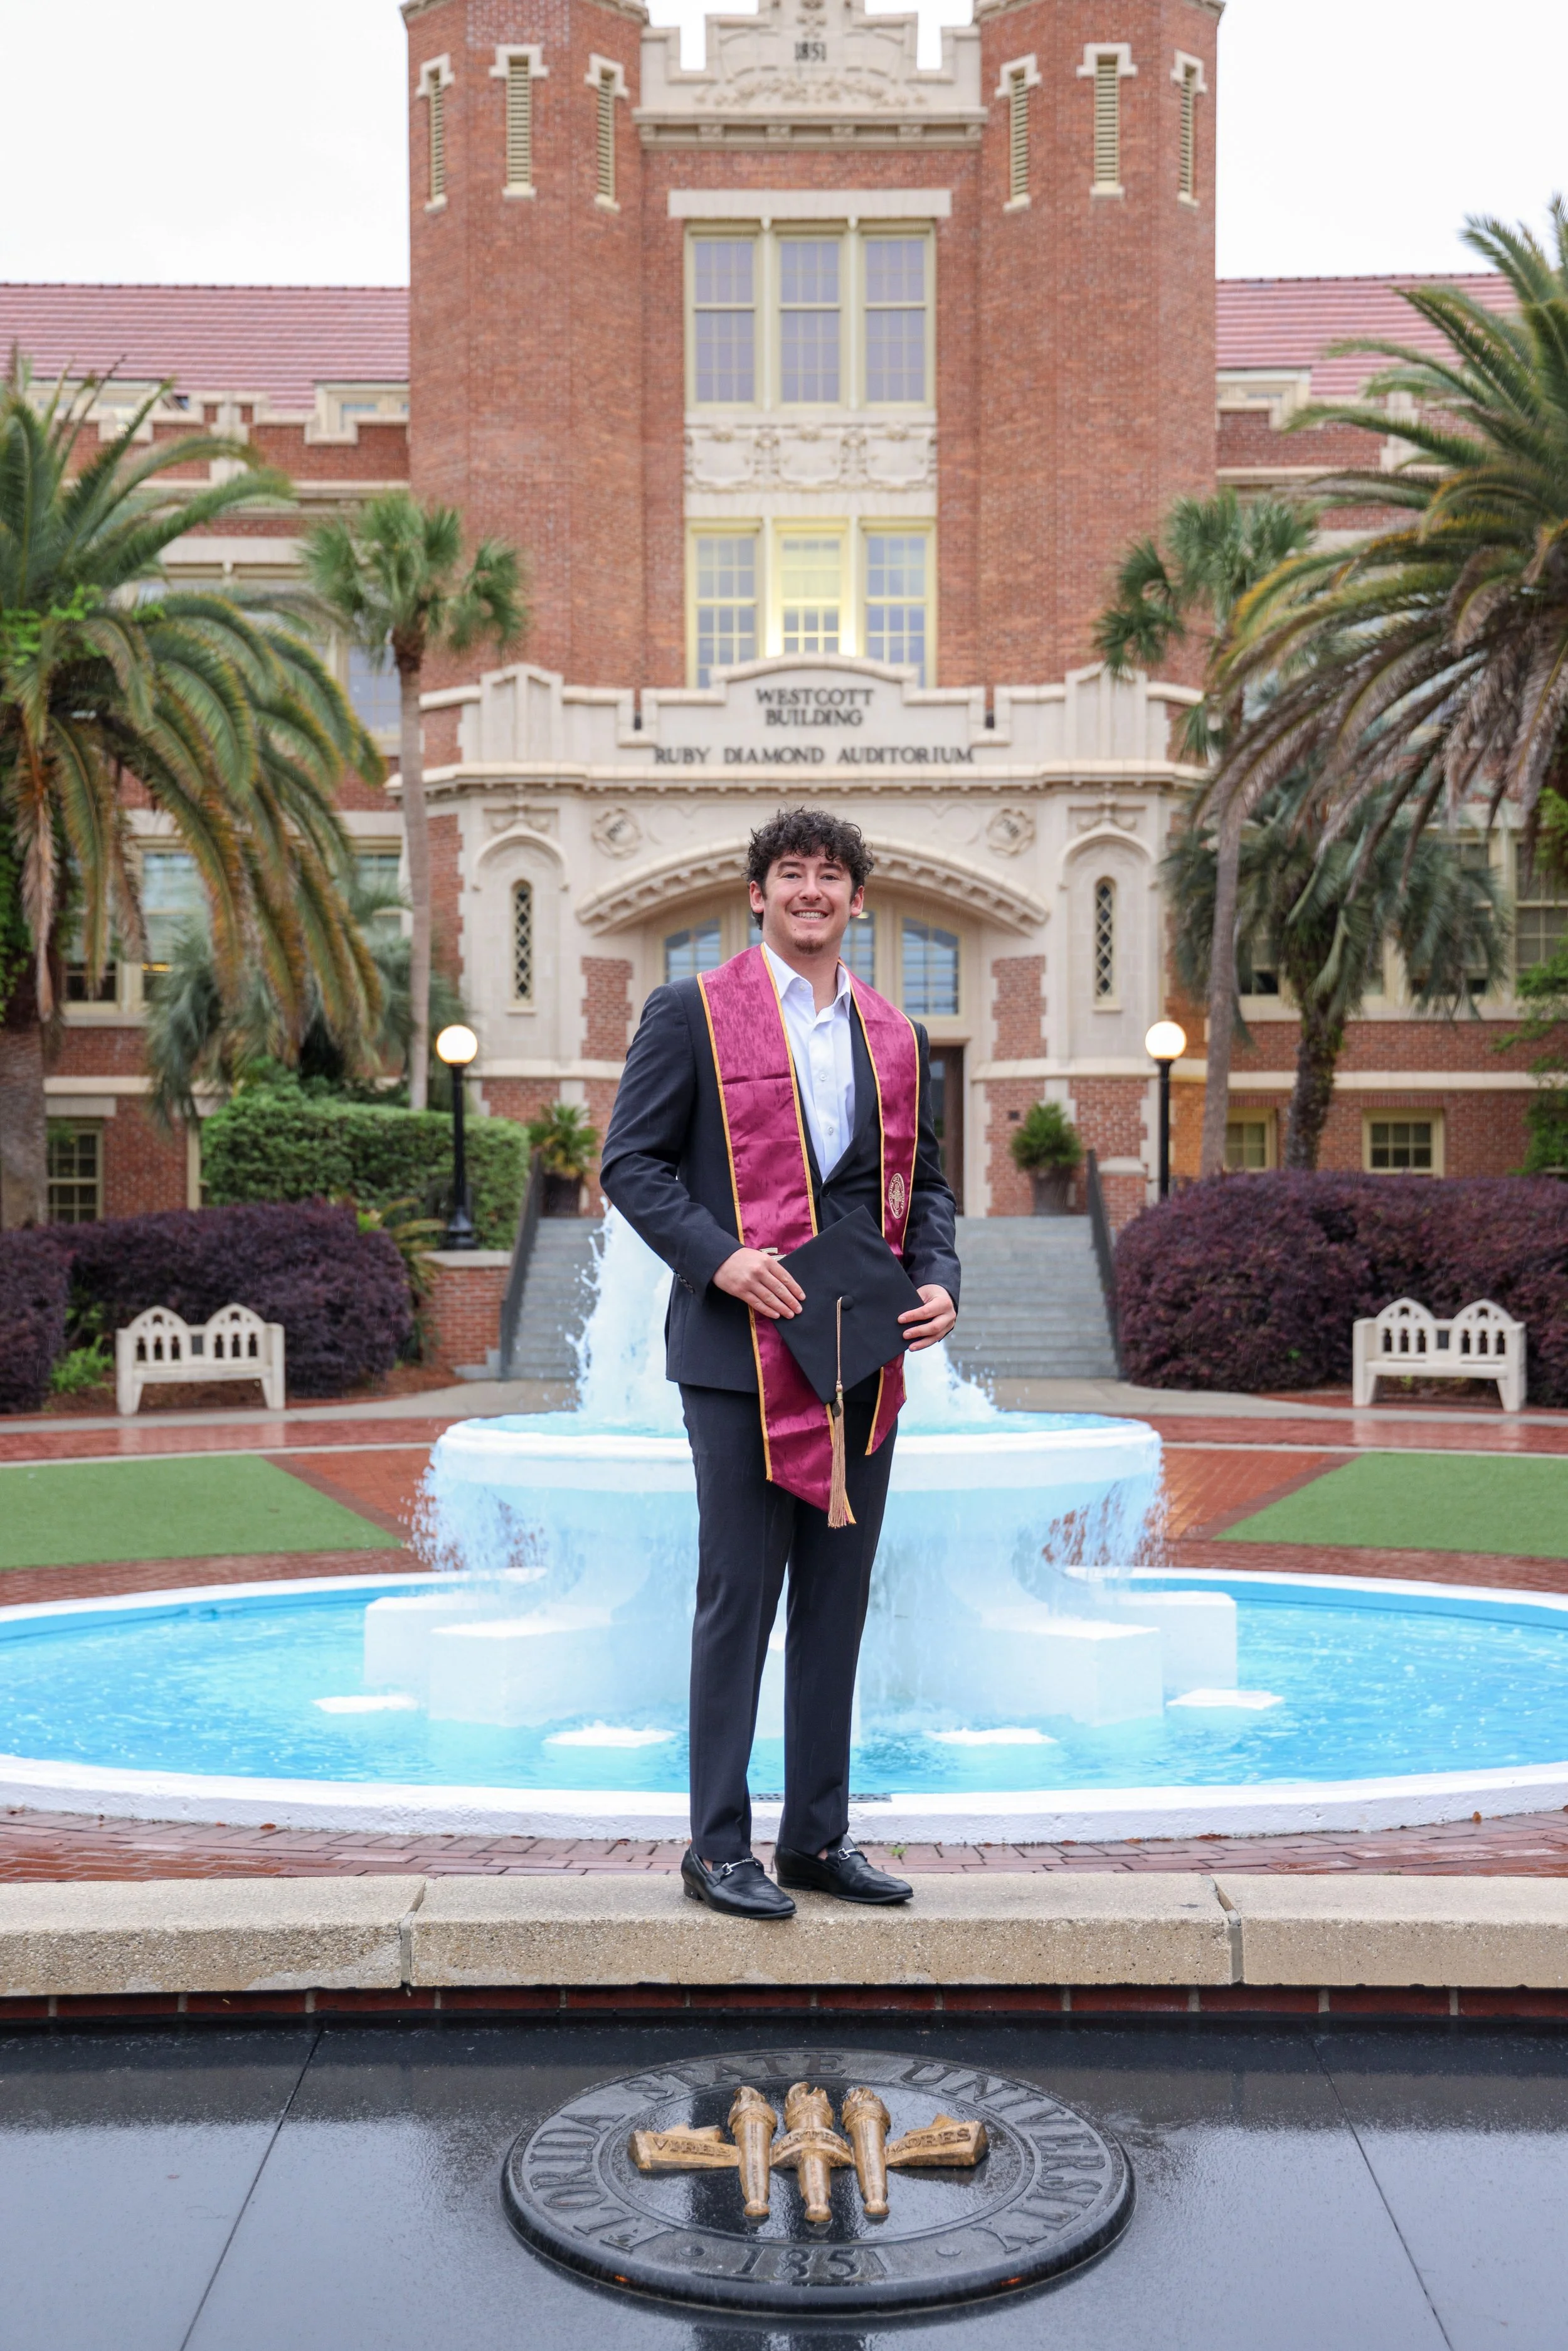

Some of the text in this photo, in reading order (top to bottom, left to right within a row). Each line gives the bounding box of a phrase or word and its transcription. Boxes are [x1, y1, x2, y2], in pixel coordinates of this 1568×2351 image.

[756, 688, 875, 705] WESTCOTT
[765, 709, 864, 726] BUILDING
[654, 746, 975, 765] RUBY DIAMOND AUDITORIUM
[528, 2053, 1106, 2253] FLORIDA STATE UNIVERSITY
[652, 2136, 732, 2158] VIRES
[731, 2246, 906, 2279] 1851
